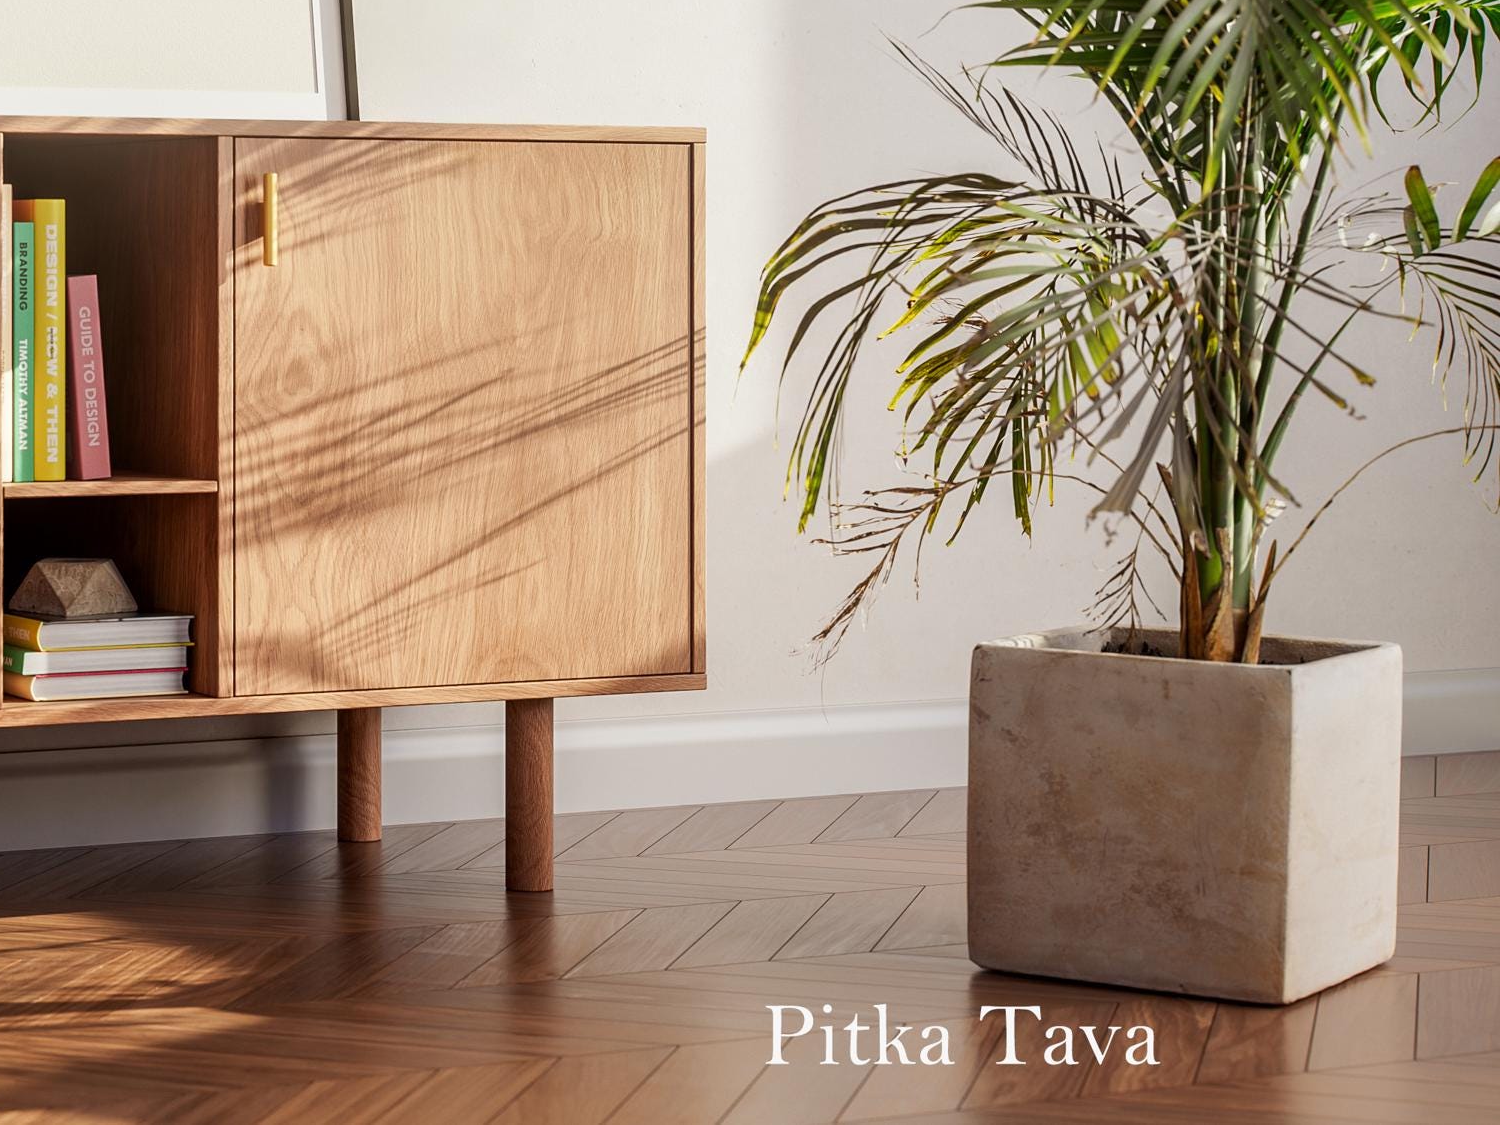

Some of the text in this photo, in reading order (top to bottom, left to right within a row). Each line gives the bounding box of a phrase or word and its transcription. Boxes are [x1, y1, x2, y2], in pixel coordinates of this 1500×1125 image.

[19, 242, 28, 311] BRANDING
[46, 224, 58, 307] DESIGN
[18, 339, 28, 450] TIMOTHY ALTMAN
[47, 383, 58, 399] &
[79, 306, 101, 447] GUIDE TO DESIGN
[47, 405, 58, 463] THEN
